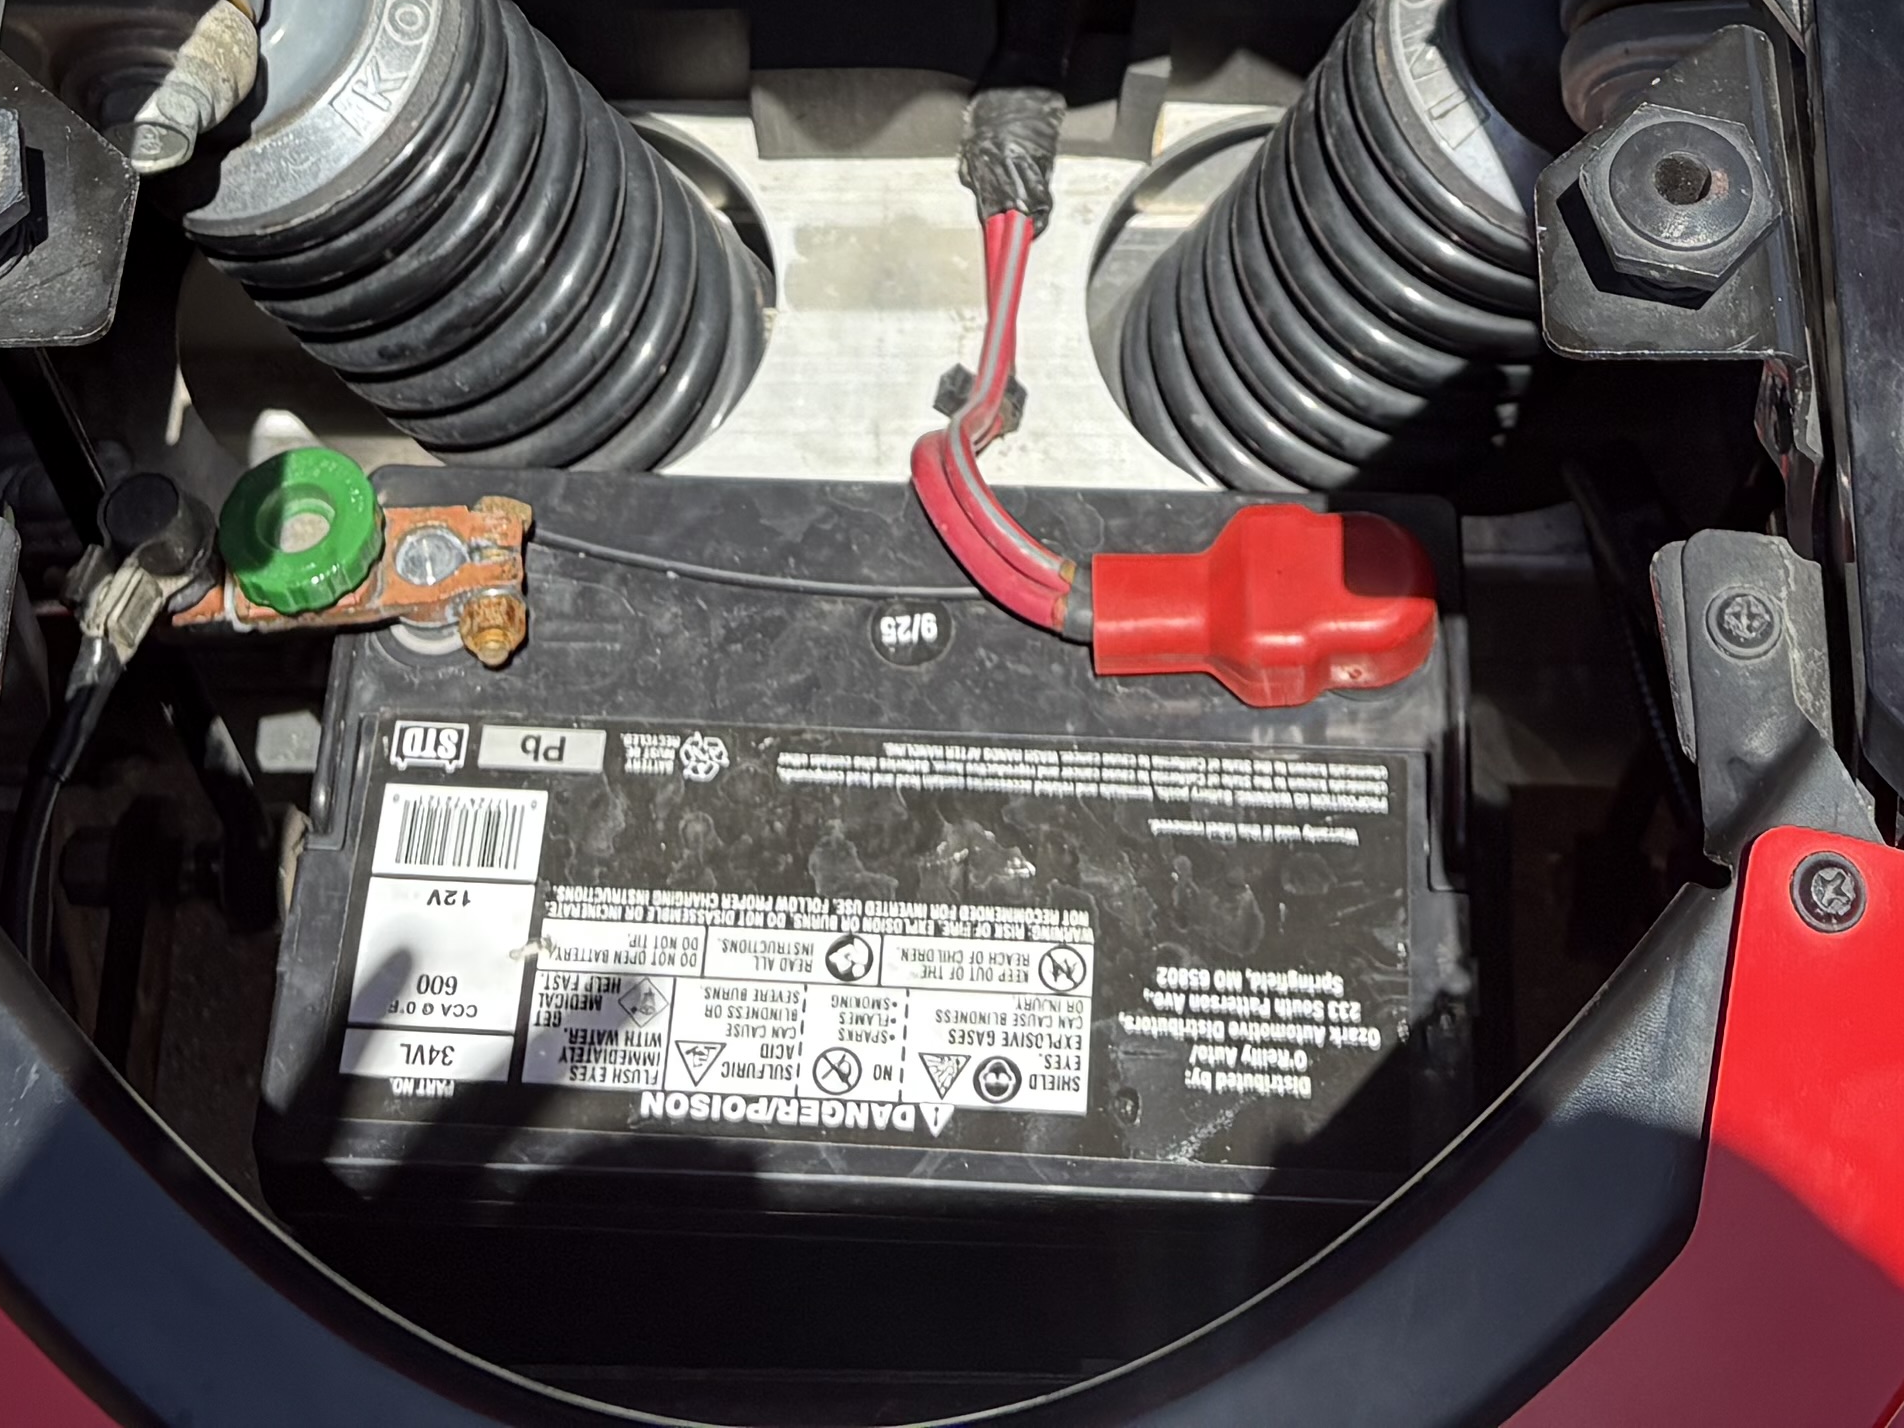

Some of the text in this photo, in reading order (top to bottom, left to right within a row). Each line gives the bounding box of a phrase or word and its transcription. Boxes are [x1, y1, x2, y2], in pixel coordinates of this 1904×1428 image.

[880, 613, 938, 644] 9/25
[403, 727, 459, 759] STD
[520, 734, 566, 762] Pb
[427, 889, 471, 907] 12V
[553, 885, 648, 906] INSTRUCTIONS.
[652, 890, 718, 908] CHARGING
[722, 893, 772, 910] PROPER
[775, 895, 829, 912] FOLLOW
[625, 904, 644, 921] OR
[647, 906, 735, 926] DISASSEMBLE
[866, 900, 927, 918] INVERTED
[930, 904, 955, 920] FOR
[960, 906, 1060, 924] RECOMMENDED
[739, 910, 765, 927] NOT
[767, 911, 786, 928] DO
[845, 916, 859, 931] OR
[862, 918, 935, 935] EXPLOSION
[1062, 910, 1089, 927] NOT
[976, 923, 991, 936] OF
[995, 925, 1025, 939] RISK
[1029, 927, 1094, 944] WARNING:
[627, 934, 698, 951] DO NOT TIP.
[718, 938, 814, 956] INSTRUCTIONS.
[613, 950, 696, 966] DO NOT OPEN
[754, 956, 812, 972] READ ALL
[896, 948, 1029, 967] REACH OF CHILDREN.
[541, 973, 620, 992] HELP FAST.
[920, 966, 1029, 982] KEEP OUT OF THE
[1214, 969, 1242, 992] MO
[1246, 969, 1343, 997] Springfield,
[417, 974, 458, 995] 600
[539, 993, 602, 1010] MEDICAL
[700, 986, 800, 1003] SEVERE BURNS.
[441, 1004, 477, 1018] CCA
[705, 1005, 797, 1020] BLINDNESS OR
[1013, 996, 1083, 1013] OR INJURY.
[1189, 994, 1270, 1019] Patterson
[1274, 998, 1324, 1021] South
[1327, 1001, 1361, 1022] 233
[534, 1012, 561, 1028] GET
[936, 1010, 1083, 1029] CAN CAUSE BLINDNESS
[564, 1028, 661, 1046] WITH WATER.
[725, 1023, 796, 1038] CAN CAUSE
[949, 1029, 1081, 1050] EXPLOSIVE GASES
[1119, 1012, 1380, 1050] Ozark Automotive Distributors,
[400, 1043, 455, 1066] 34VL
[559, 1047, 660, 1066] IMMEDIATELY
[760, 1043, 794, 1059] ACID
[1190, 1045, 1307, 1072] O'Reilly Auto/
[720, 1061, 793, 1080] SULFURIC
[1038, 1053, 1081, 1070] EYES.
[570, 1066, 658, 1084] FLUSH EYES
[874, 1065, 892, 1081] NO
[390, 1077, 454, 1097] PART NO.
[1029, 1076, 1080, 1091] SHIELD
[1185, 1068, 1311, 1099] Distributed by:
[640, 1091, 915, 1132] DANGER/POISON
